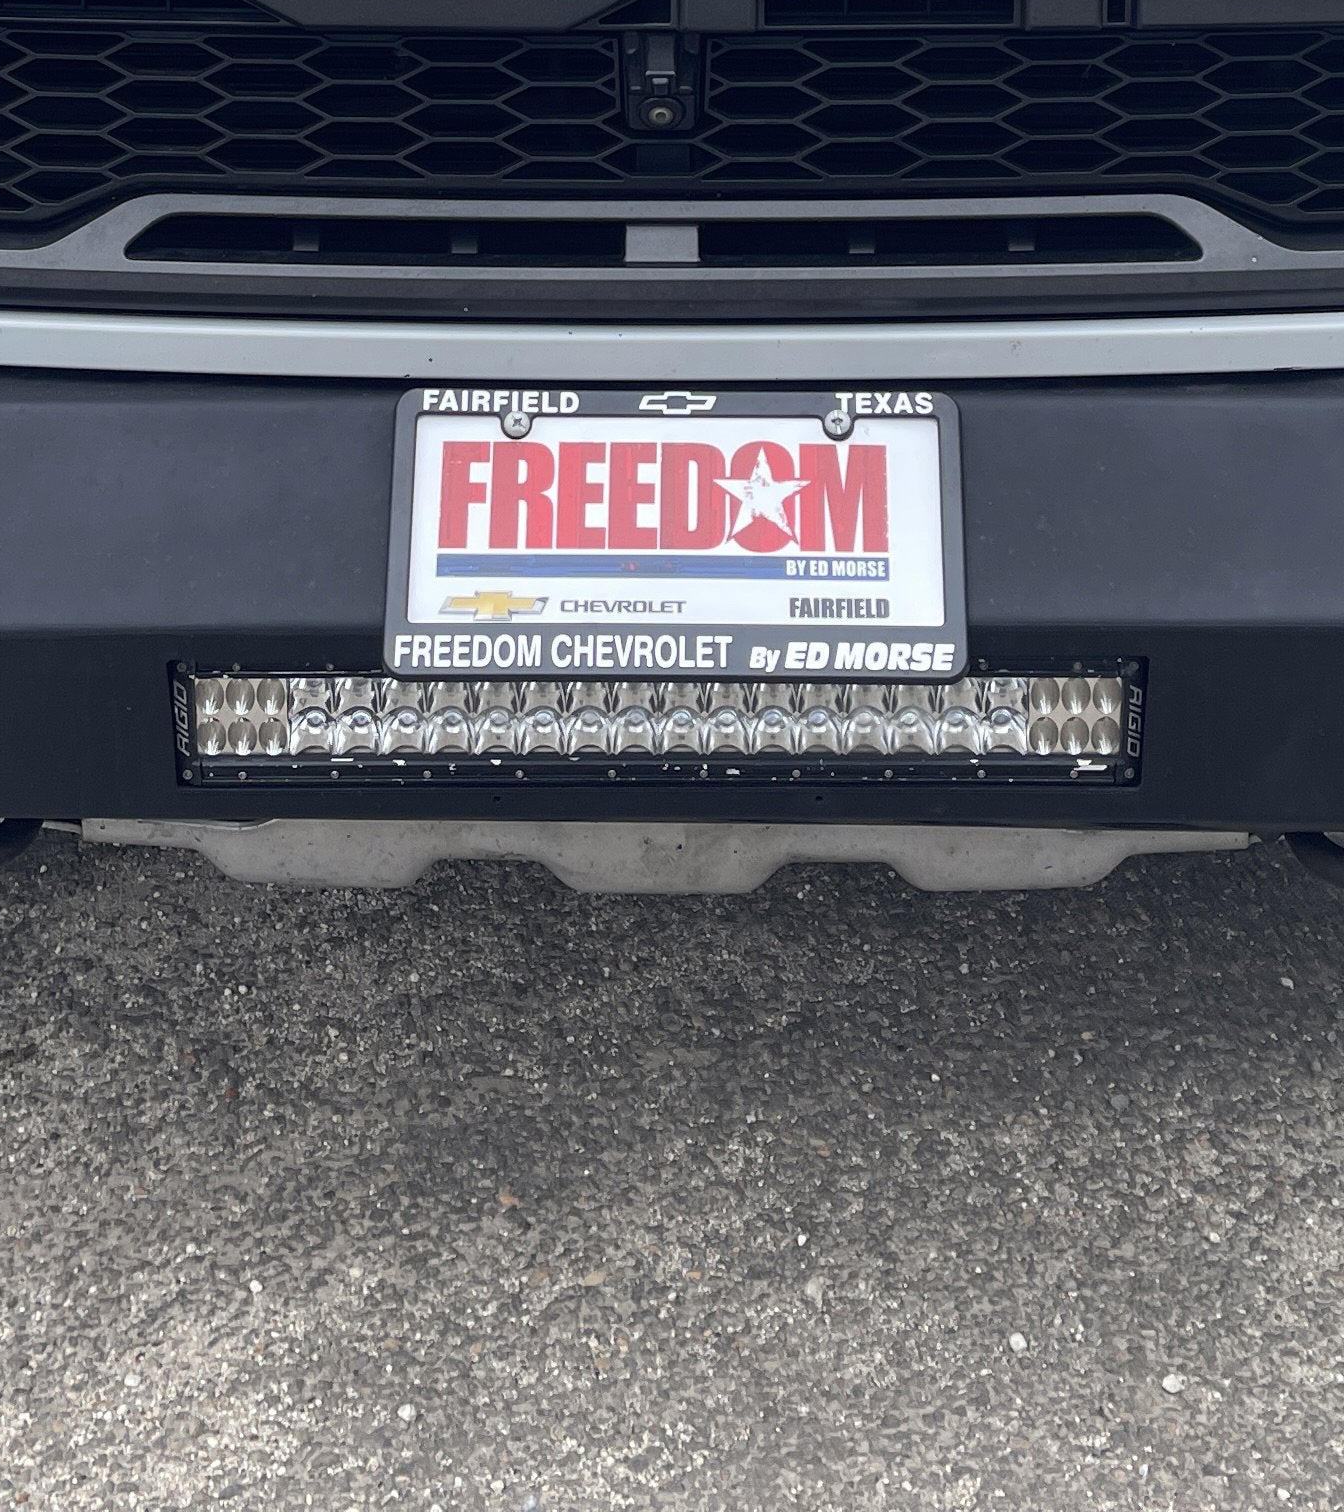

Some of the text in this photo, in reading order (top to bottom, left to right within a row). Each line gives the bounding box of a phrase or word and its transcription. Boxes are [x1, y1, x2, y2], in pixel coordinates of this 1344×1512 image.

[422, 389, 580, 414] FAIRFIELD
[835, 392, 934, 414] TEXAS
[437, 440, 889, 553] FREEDOM
[785, 560, 886, 577] BY ED MORSE
[560, 600, 687, 614] CHEVROLET
[789, 597, 890, 619] FAIRFIELD
[394, 634, 956, 673] FREEDOM CHEVROLET By ED MORSE
[173, 679, 190, 757] RIGID
[1127, 684, 1143, 758] RIGID
